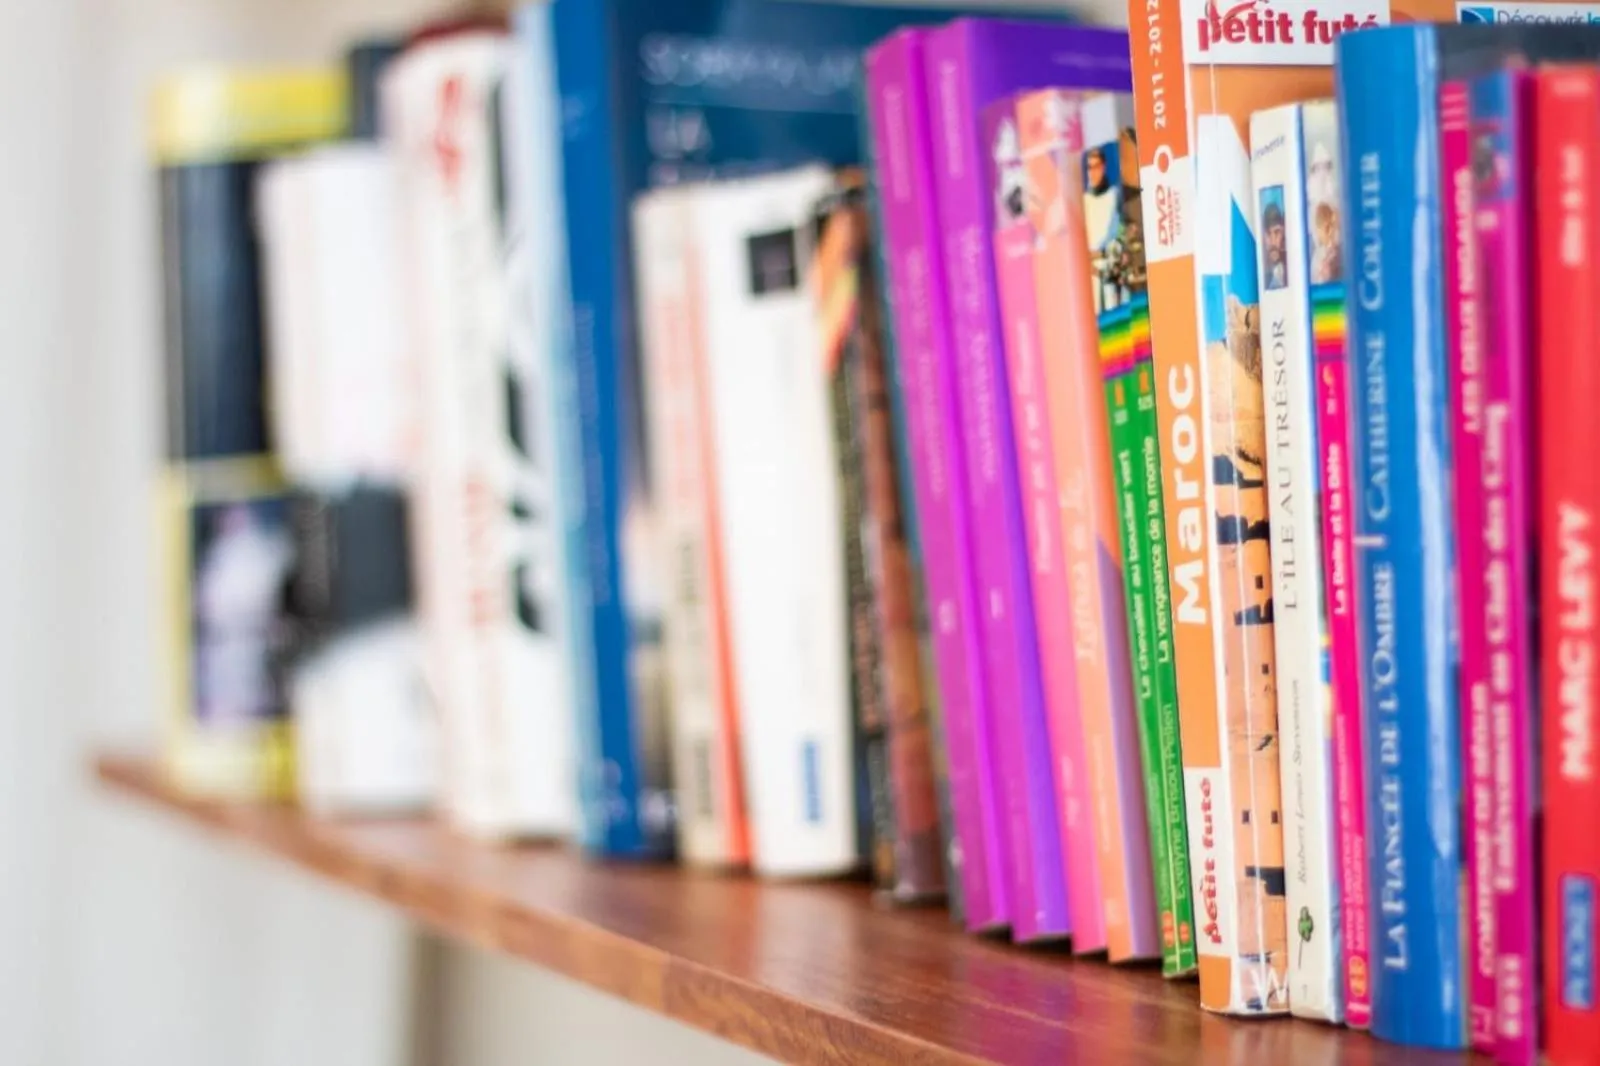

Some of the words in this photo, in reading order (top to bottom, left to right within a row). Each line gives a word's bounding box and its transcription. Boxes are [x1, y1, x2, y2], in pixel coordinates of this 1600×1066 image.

[1198, 7, 1294, 51] petit
[1155, 184, 1168, 246] DVD
[1358, 152, 1384, 310] COULTER
[1272, 318, 1291, 456] TRÉSOR
[1365, 331, 1391, 521] CATHERINE
[1117, 450, 1132, 486] vert
[1141, 436, 1157, 495] momie
[1168, 363, 1207, 624] Maroc
[1278, 466, 1294, 516] AU
[1122, 491, 1139, 561] bouclier
[1145, 497, 1158, 515] la
[1147, 518, 1162, 540] de
[1328, 493, 1342, 511] la
[1330, 515, 1343, 535] et
[1130, 564, 1142, 587] au
[1149, 544, 1169, 635] vengeance
[1279, 526, 1297, 610] L'ÎLE
[1330, 538, 1345, 585] Belle
[1557, 501, 1592, 631] LEVY
[1132, 593, 1149, 671] chevalier
[1333, 590, 1346, 614] La
[1157, 638, 1170, 663] La
[1372, 563, 1397, 710] L'OMBRE
[1139, 675, 1152, 698] Le
[1558, 640, 1592, 779] MARC
[1292, 679, 1303, 766] Stevenson
[1380, 723, 1398, 764] DE
[1199, 777, 1214, 848] futé
[1169, 827, 1186, 899] Evelyne
[1296, 824, 1307, 884] Robert
[1380, 775, 1405, 913] FIANCÉE
[1200, 857, 1222, 944] petit
[1383, 925, 1408, 970] LA
